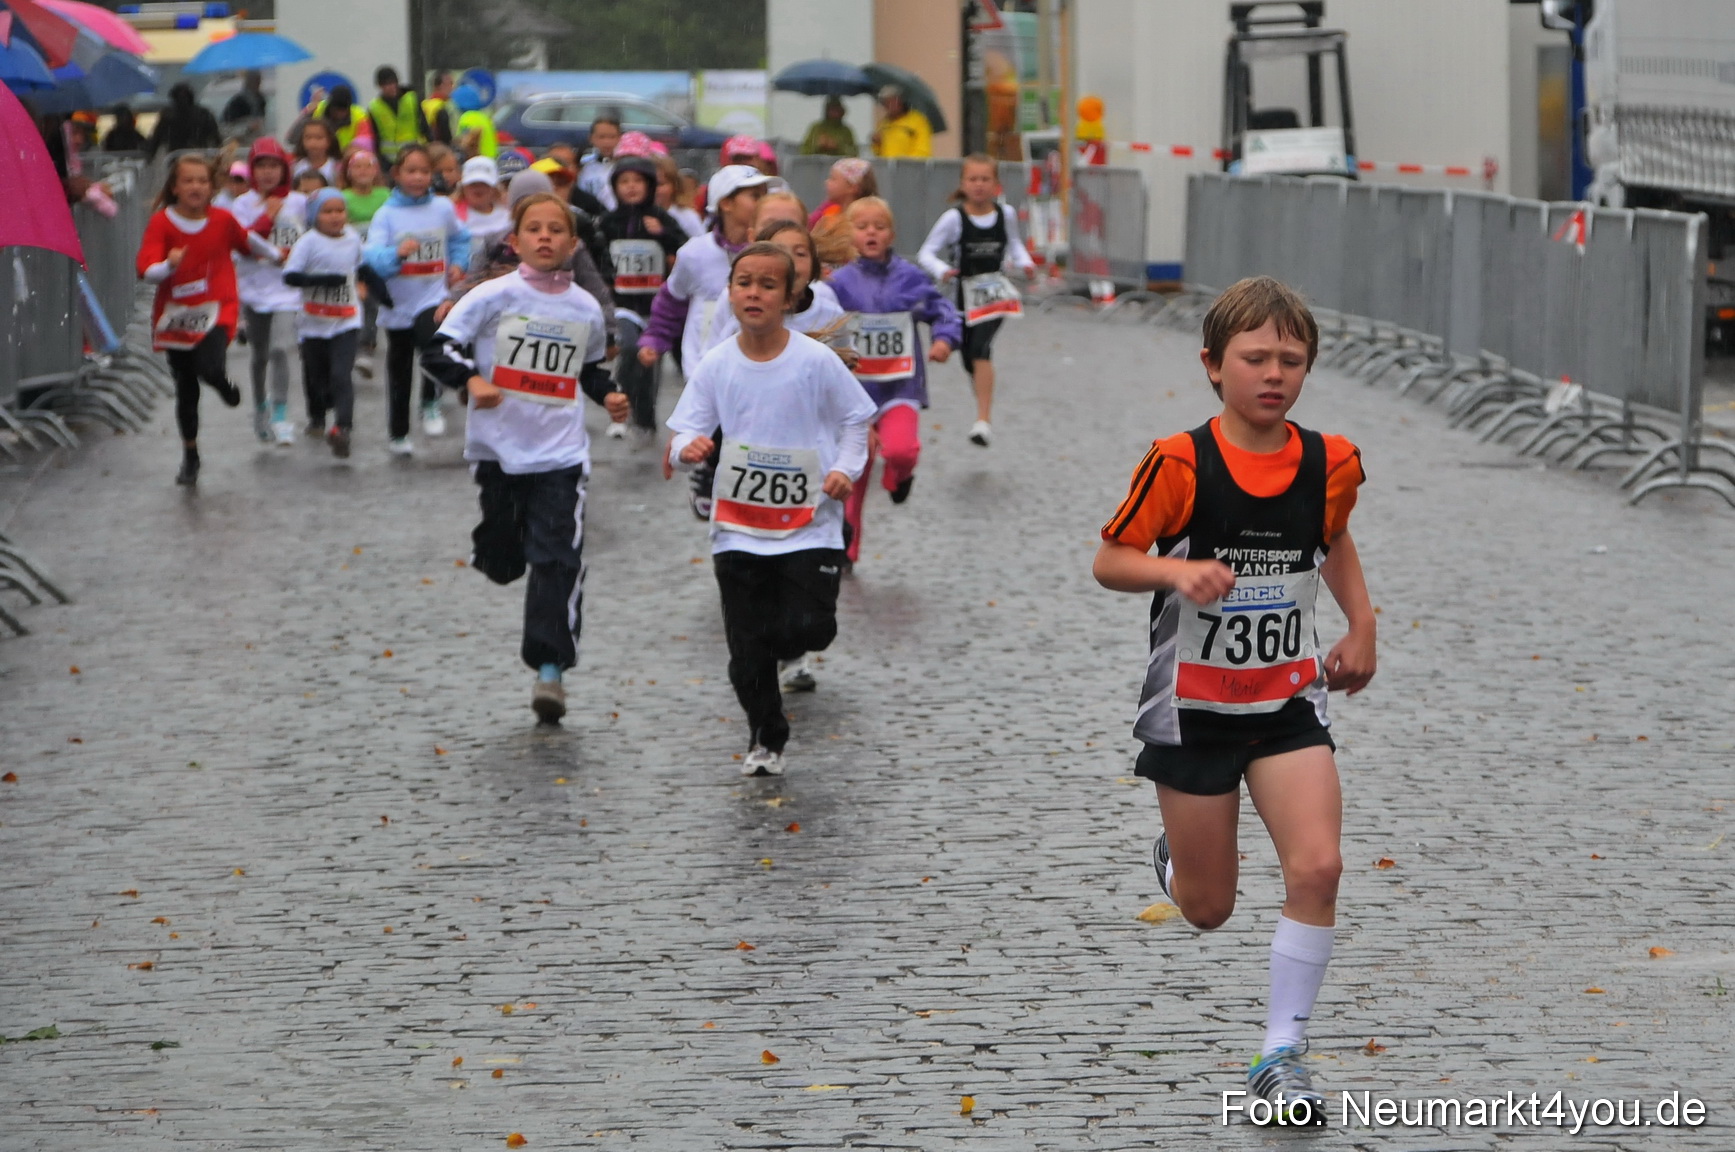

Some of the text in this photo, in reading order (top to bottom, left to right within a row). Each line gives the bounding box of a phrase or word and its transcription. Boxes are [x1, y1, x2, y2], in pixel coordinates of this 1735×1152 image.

[508, 335, 577, 373] 7107
[731, 465, 808, 505] 7263
[1229, 548, 1302, 563] INTERSPORT
[1230, 562, 1291, 576] LANGE
[1225, 584, 1285, 601] BOCK
[1197, 608, 1302, 665] 7360
